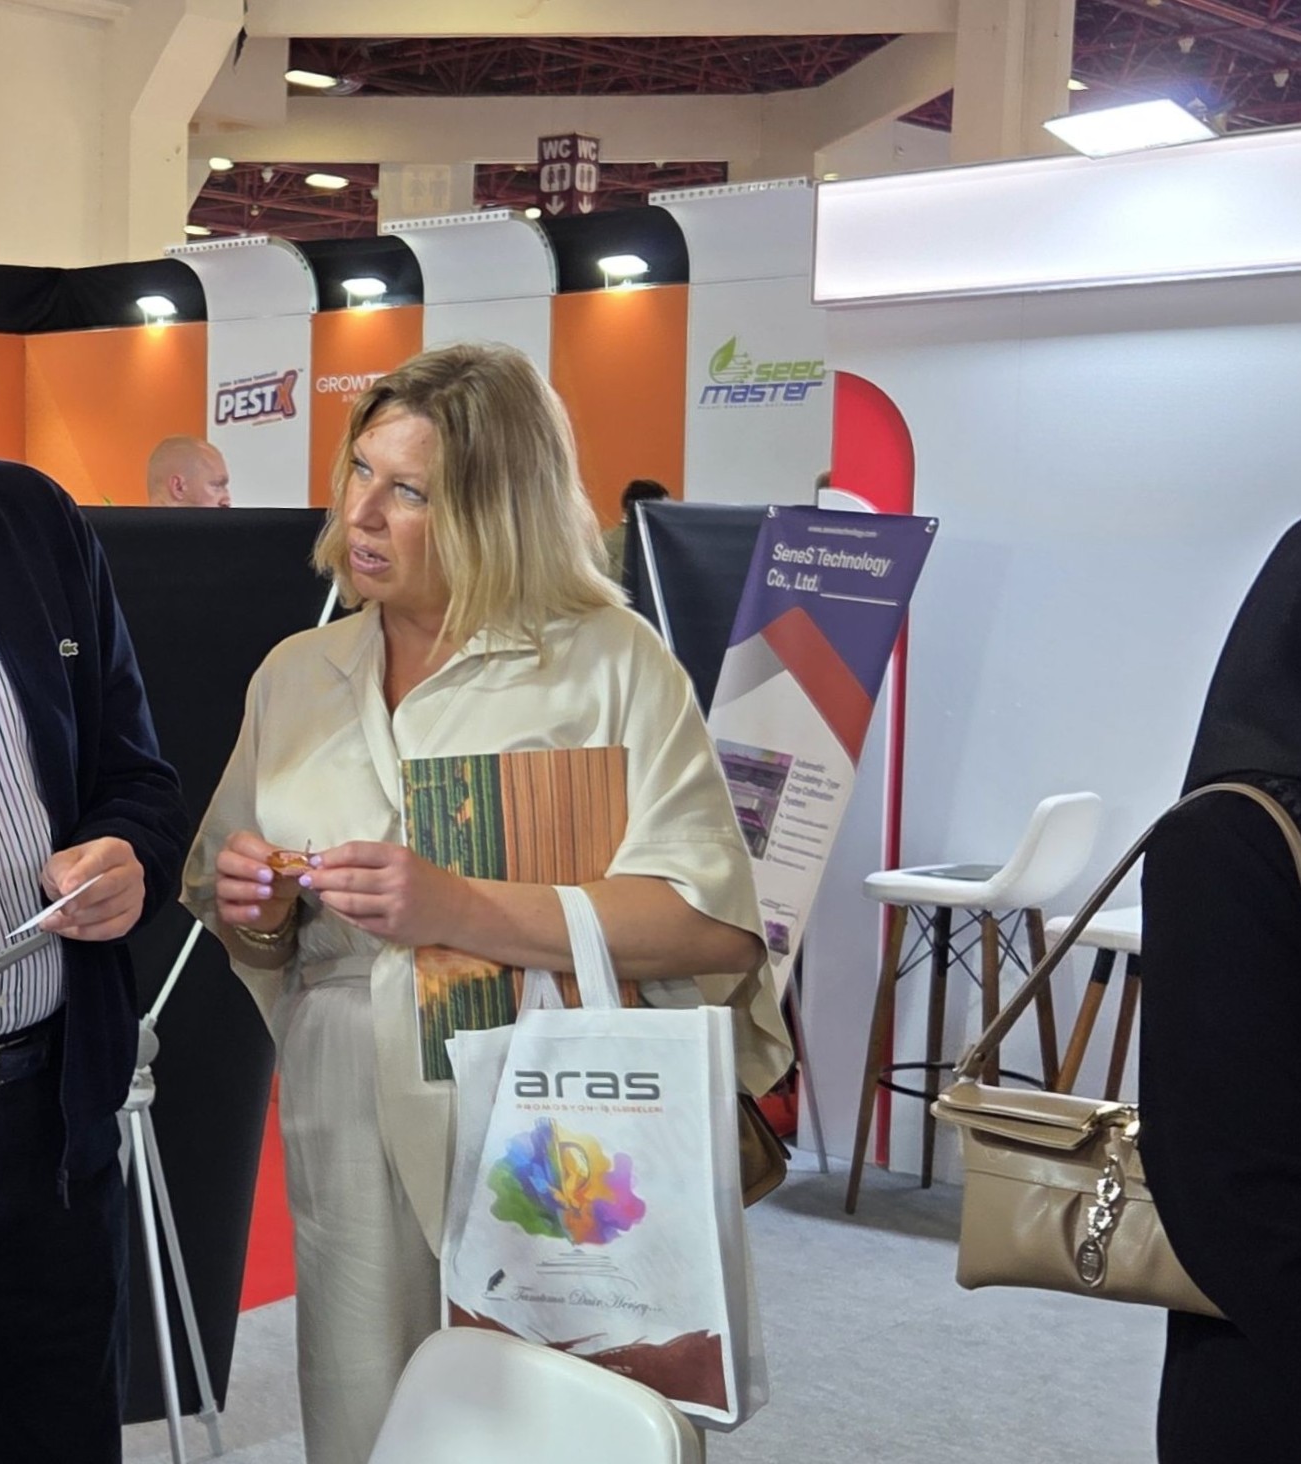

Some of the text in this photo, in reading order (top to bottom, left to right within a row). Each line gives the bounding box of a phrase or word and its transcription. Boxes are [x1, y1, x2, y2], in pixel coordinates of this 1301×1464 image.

[542, 139, 572, 160] WC
[577, 138, 597, 160] WC
[216, 371, 297, 423] PESTX
[772, 542, 891, 578] SeneS Technology
[794, 572, 818, 592] Ltd.
[514, 1070, 660, 1100] aras
